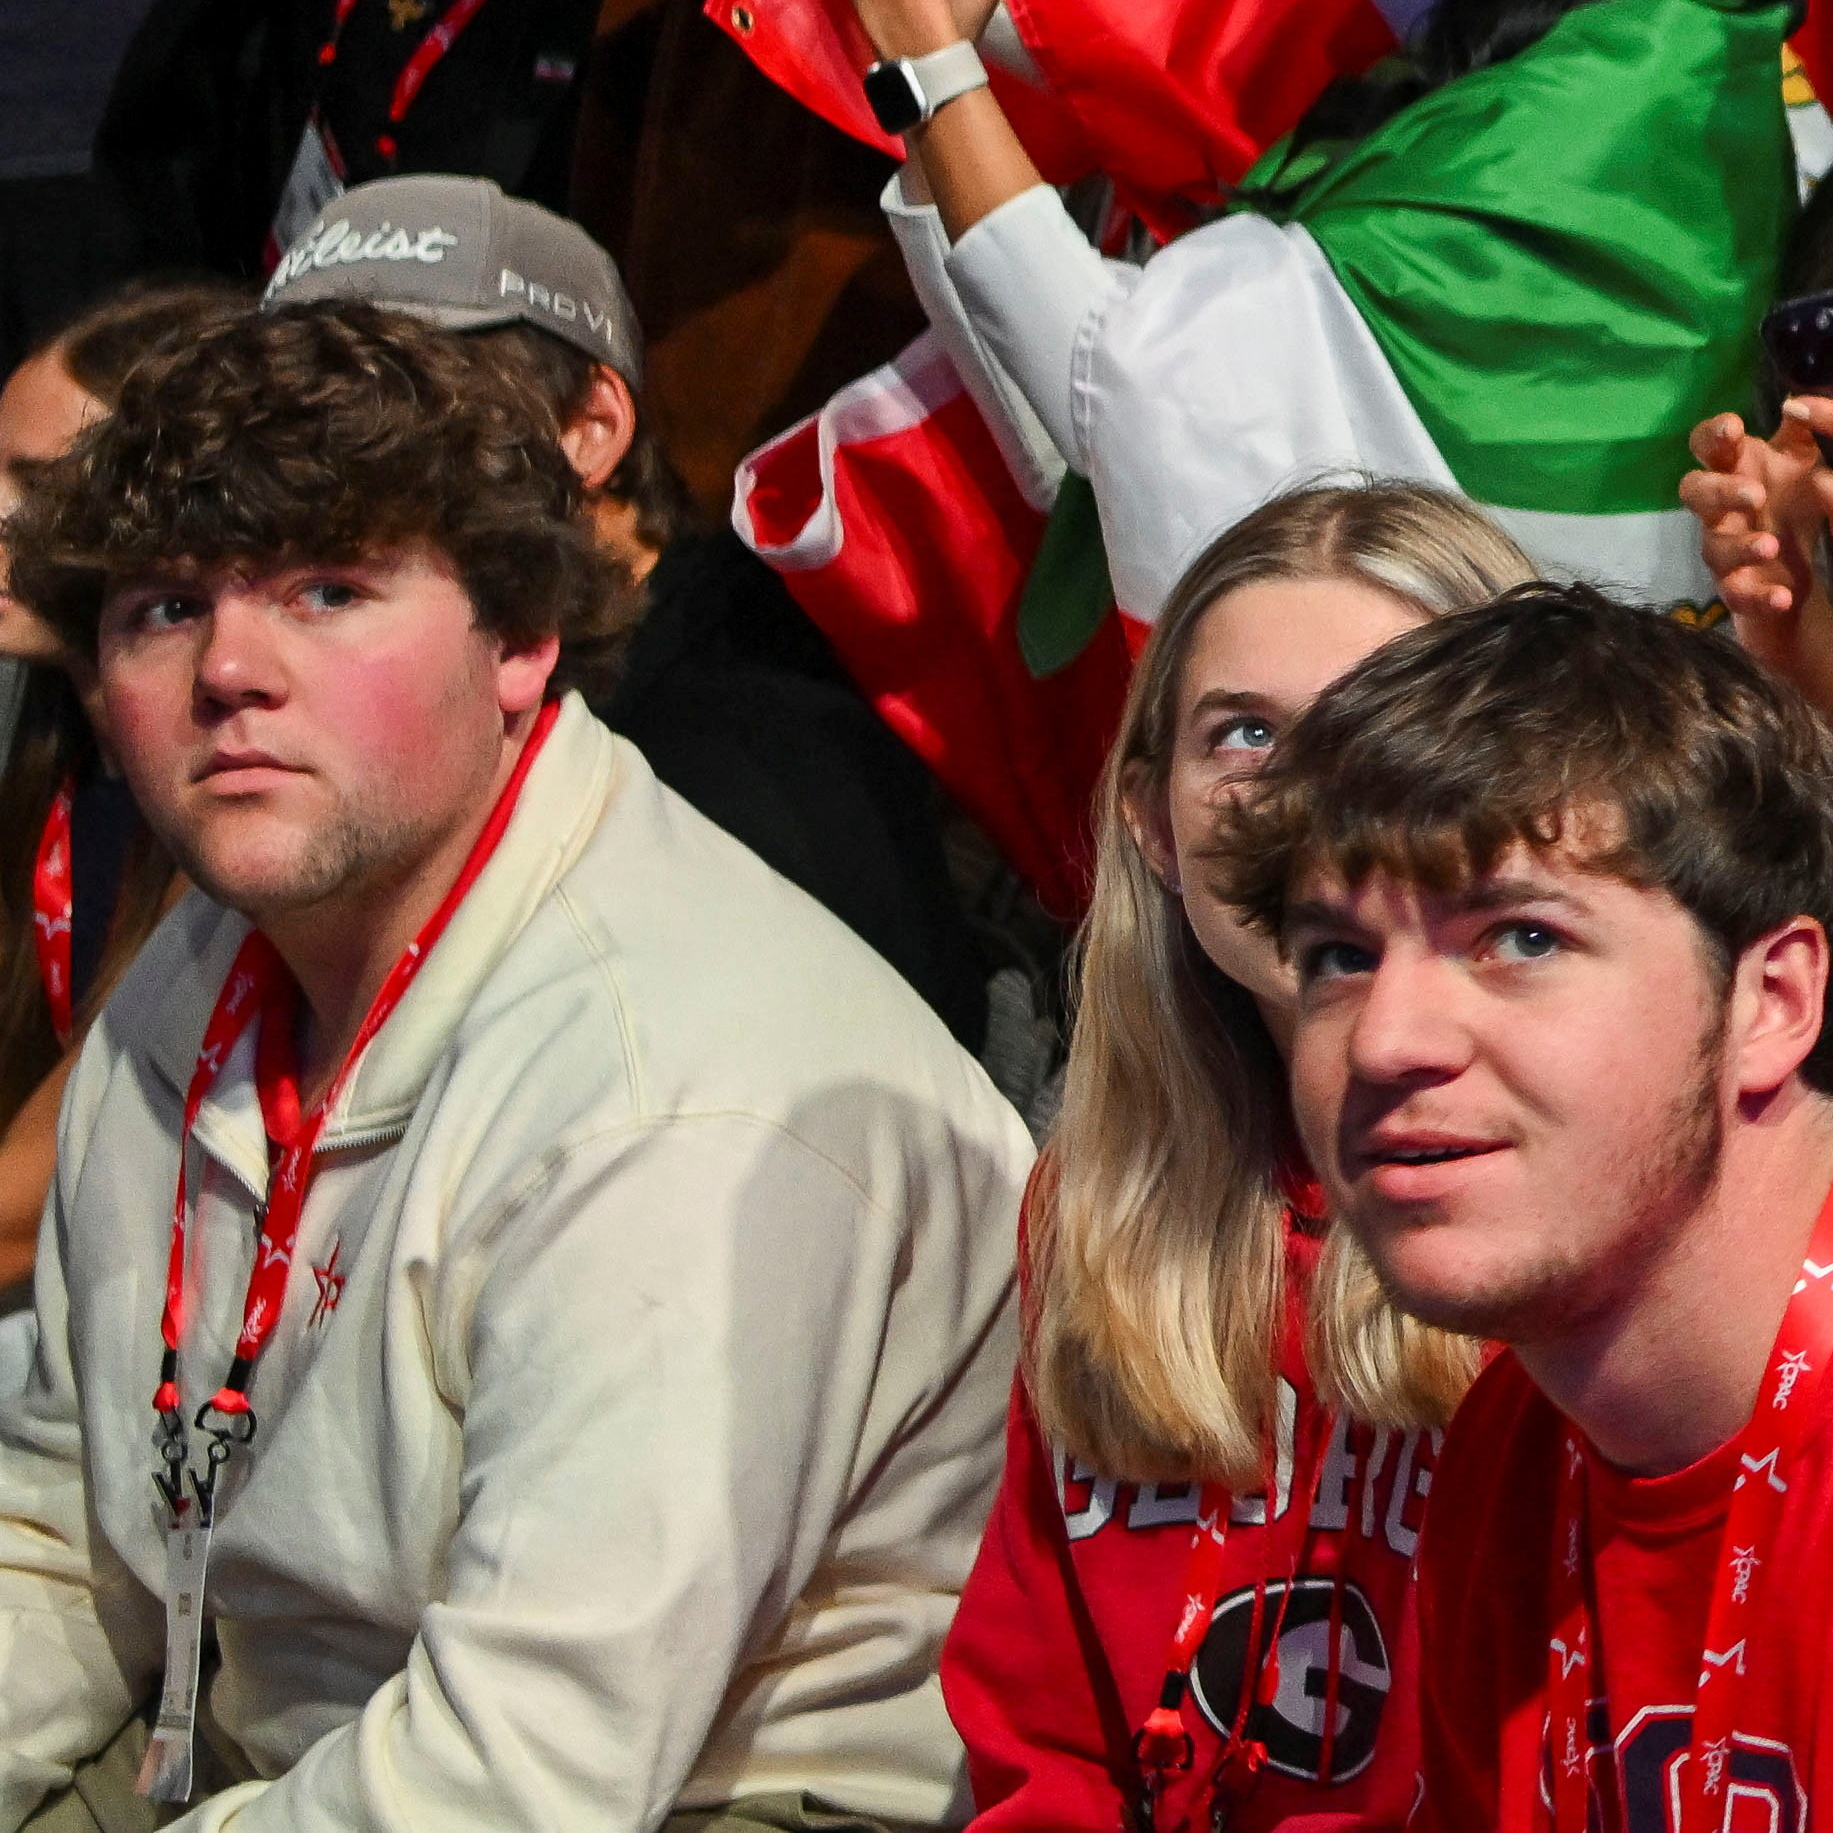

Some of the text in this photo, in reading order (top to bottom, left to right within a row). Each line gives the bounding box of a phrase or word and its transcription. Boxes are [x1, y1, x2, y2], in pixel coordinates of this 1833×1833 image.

[500, 268, 577, 322] PRO
[1772, 1358, 1804, 1411] CPAC
[1731, 1553, 1754, 1605] CPAC
[1703, 1746, 1725, 1796] CPAC
